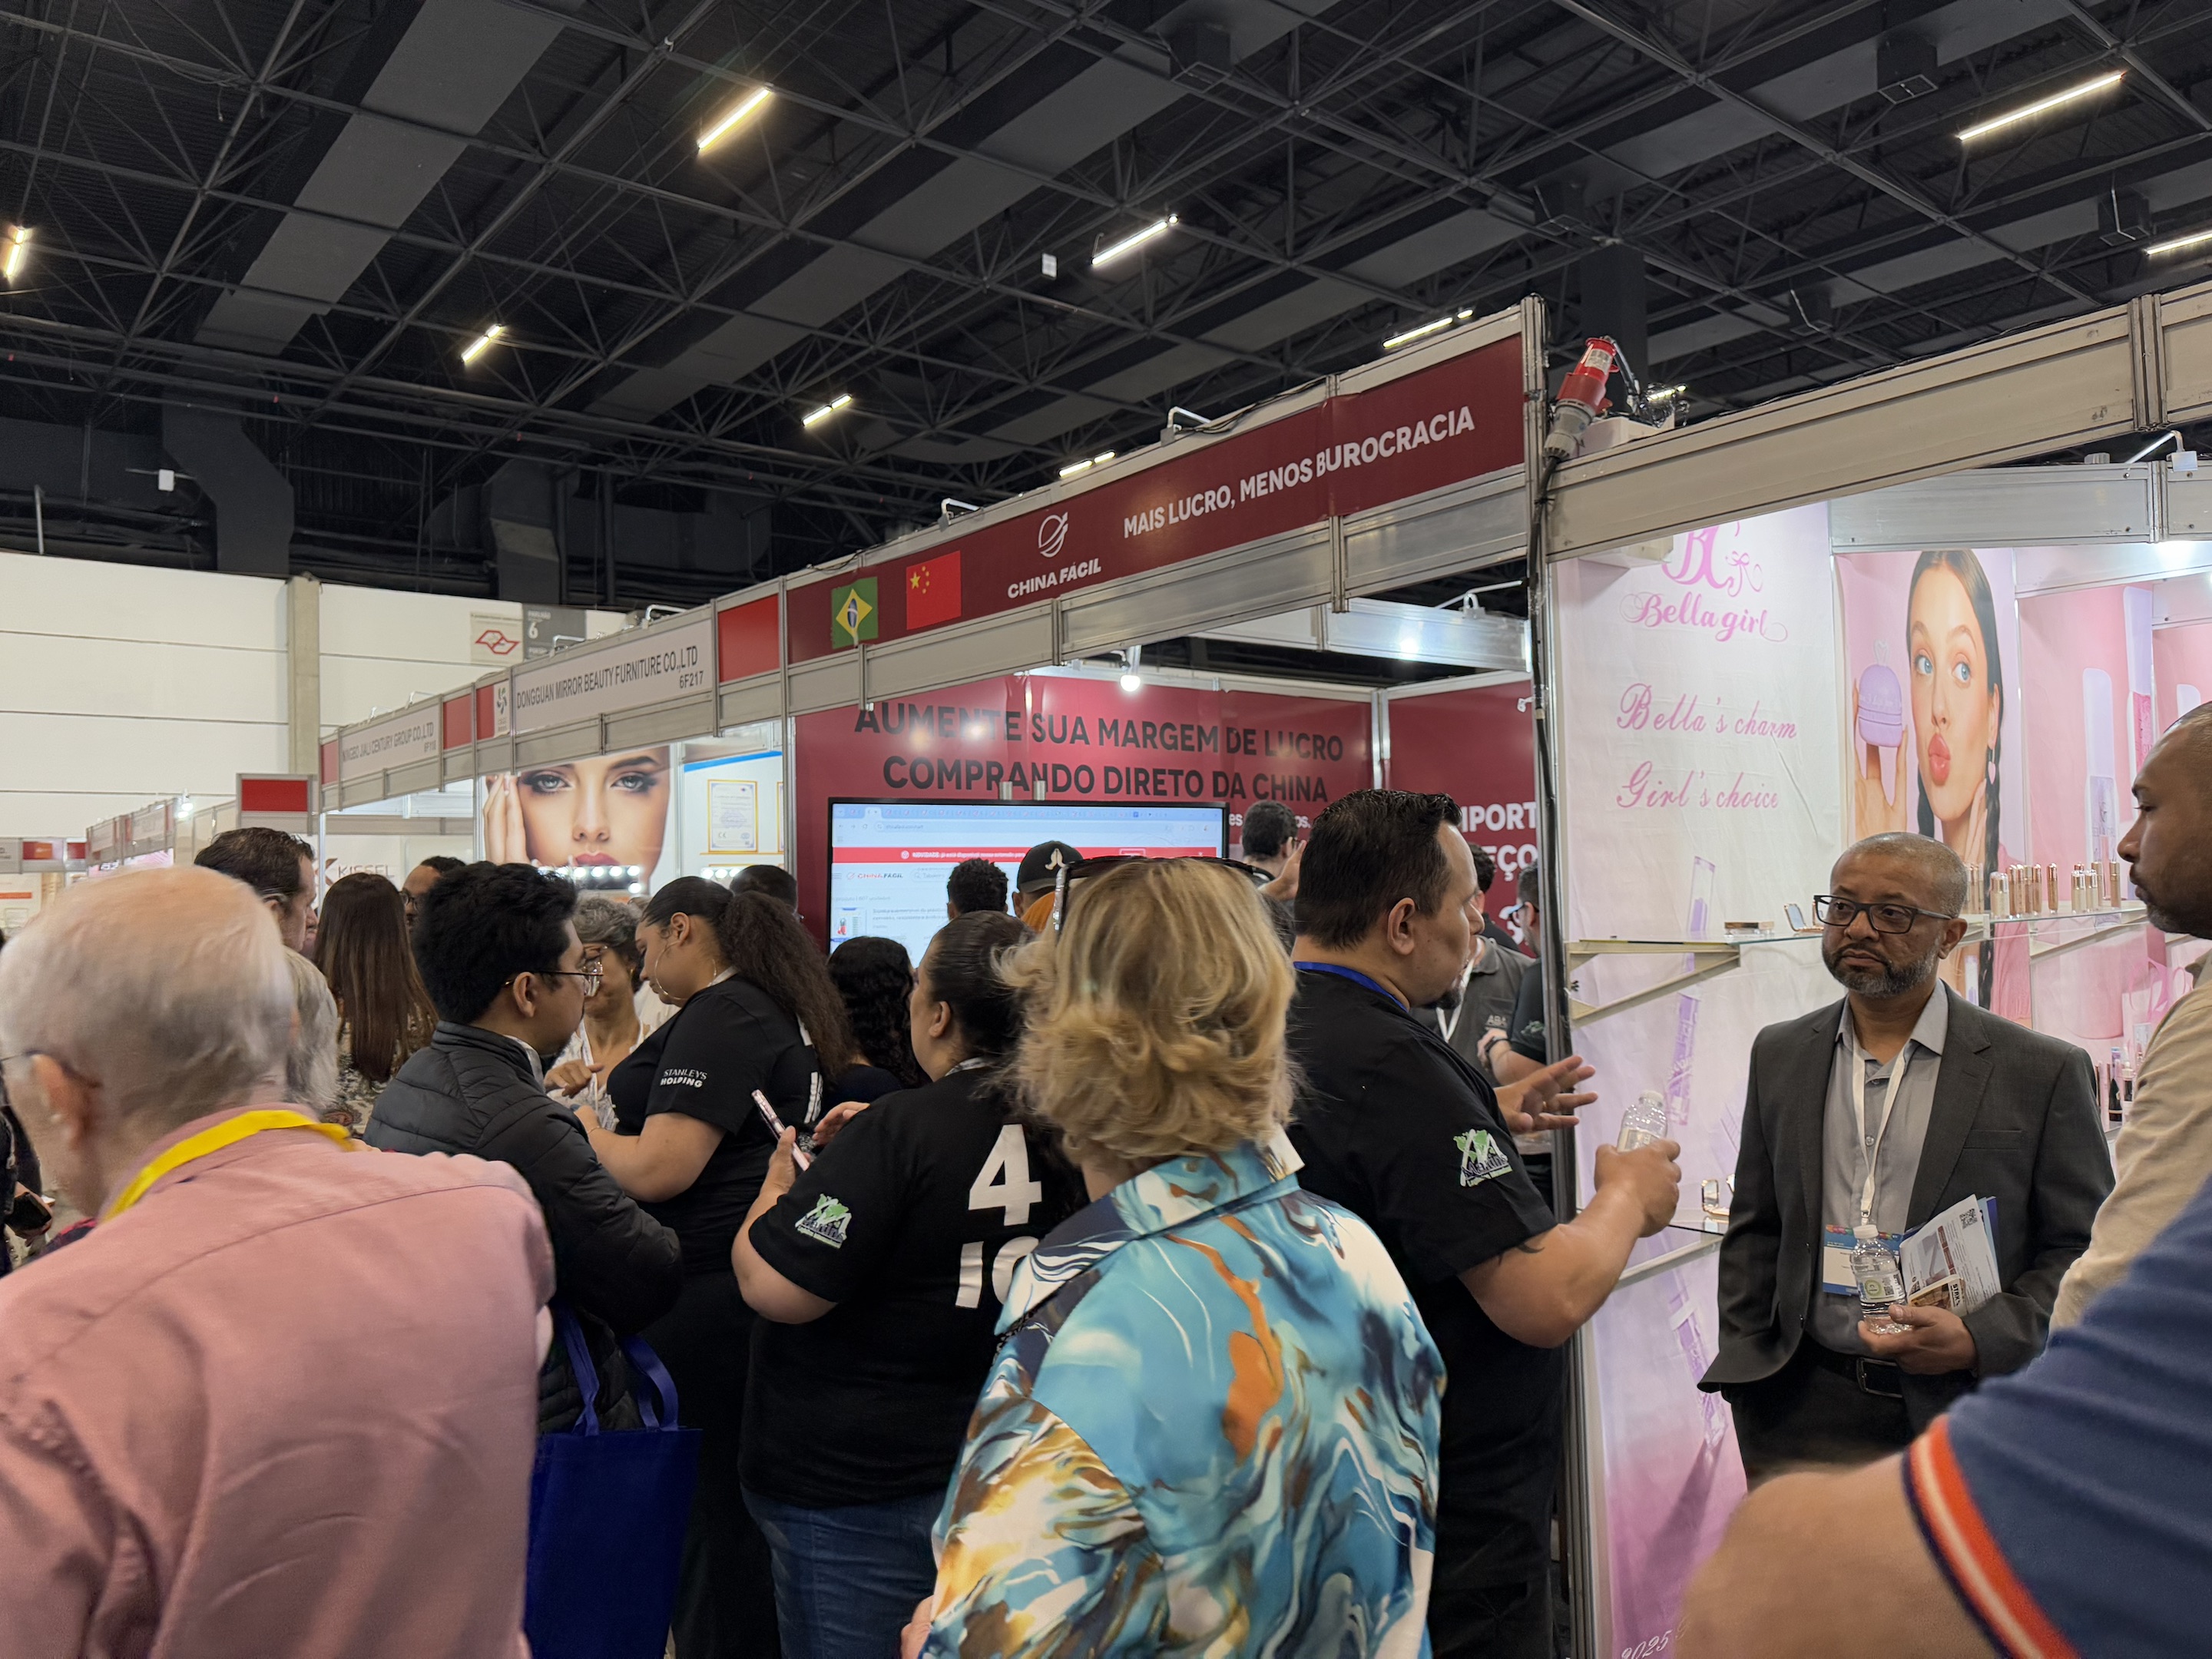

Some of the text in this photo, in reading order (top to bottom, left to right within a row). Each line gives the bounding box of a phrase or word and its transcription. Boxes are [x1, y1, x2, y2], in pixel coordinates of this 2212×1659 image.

[1124, 406, 1475, 538] MAIS LUCRO, MENOS BUROCRACIA
[1008, 571, 1058, 598] CHINA
[528, 622, 538, 639] 6
[517, 684, 555, 709] DONGGUAN
[555, 676, 582, 700] MIRROR
[584, 667, 614, 691] BEAUTY
[615, 655, 661, 684] FURNITURE
[680, 671, 704, 689] 6F217
[854, 702, 1343, 762] AUMENTE SUA MARGEM DE LUCRO
[1616, 683, 1797, 738] Bella's charm
[883, 756, 1328, 803] COMPRANDO DIRETO DA CHINA
[1616, 760, 1779, 808] Girl's choice
[660, 1076, 703, 1088] HOLDING
[969, 1124, 1042, 1227] 4
